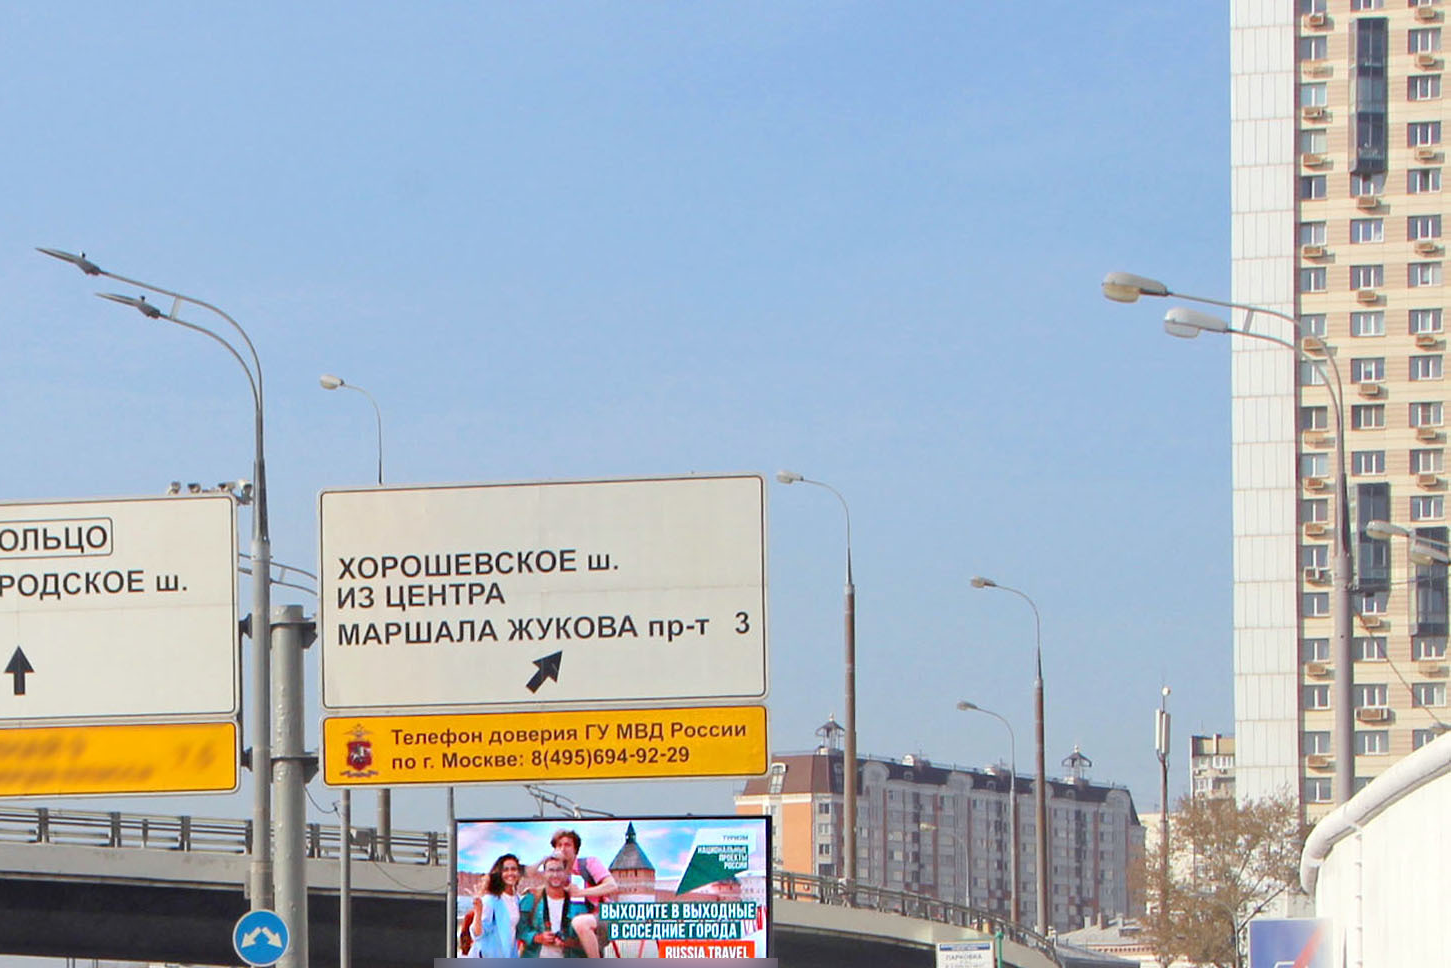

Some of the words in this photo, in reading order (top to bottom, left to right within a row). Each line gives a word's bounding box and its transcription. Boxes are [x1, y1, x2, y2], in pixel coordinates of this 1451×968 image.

[338, 549, 577, 580] ХОРОШЕВСКОЕ
[587, 553, 619, 571] ш.
[156, 574, 188, 593] ш.
[337, 586, 375, 609] ИЗ
[385, 582, 506, 611] ЦЕНТРА
[338, 618, 498, 646] МАРШАЛА
[508, 615, 638, 642] ЖУКОВА
[649, 617, 710, 643] пр-т
[734, 611, 751, 635] 3
[391, 728, 483, 749] Телефон
[488, 726, 578, 748] доверия
[585, 724, 612, 742] ГУ
[616, 723, 665, 743] МВД
[670, 721, 748, 740] России
[391, 755, 418, 770] по
[423, 756, 436, 770] г.
[442, 751, 525, 769] Москве:
[531, 747, 690, 768] 8(495)694-92-29
[601, 903, 668, 921] ВЫХОДИТЕ
[672, 903, 680, 919] В
[683, 903, 756, 920] ВЫХОДНЫЕ
[611, 923, 619, 938] В
[622, 922, 686, 940] СОСЕДНИЕ
[688, 922, 737, 940] ГОРОДА
[665, 945, 749, 959] RUSSIA.TRAVEL
